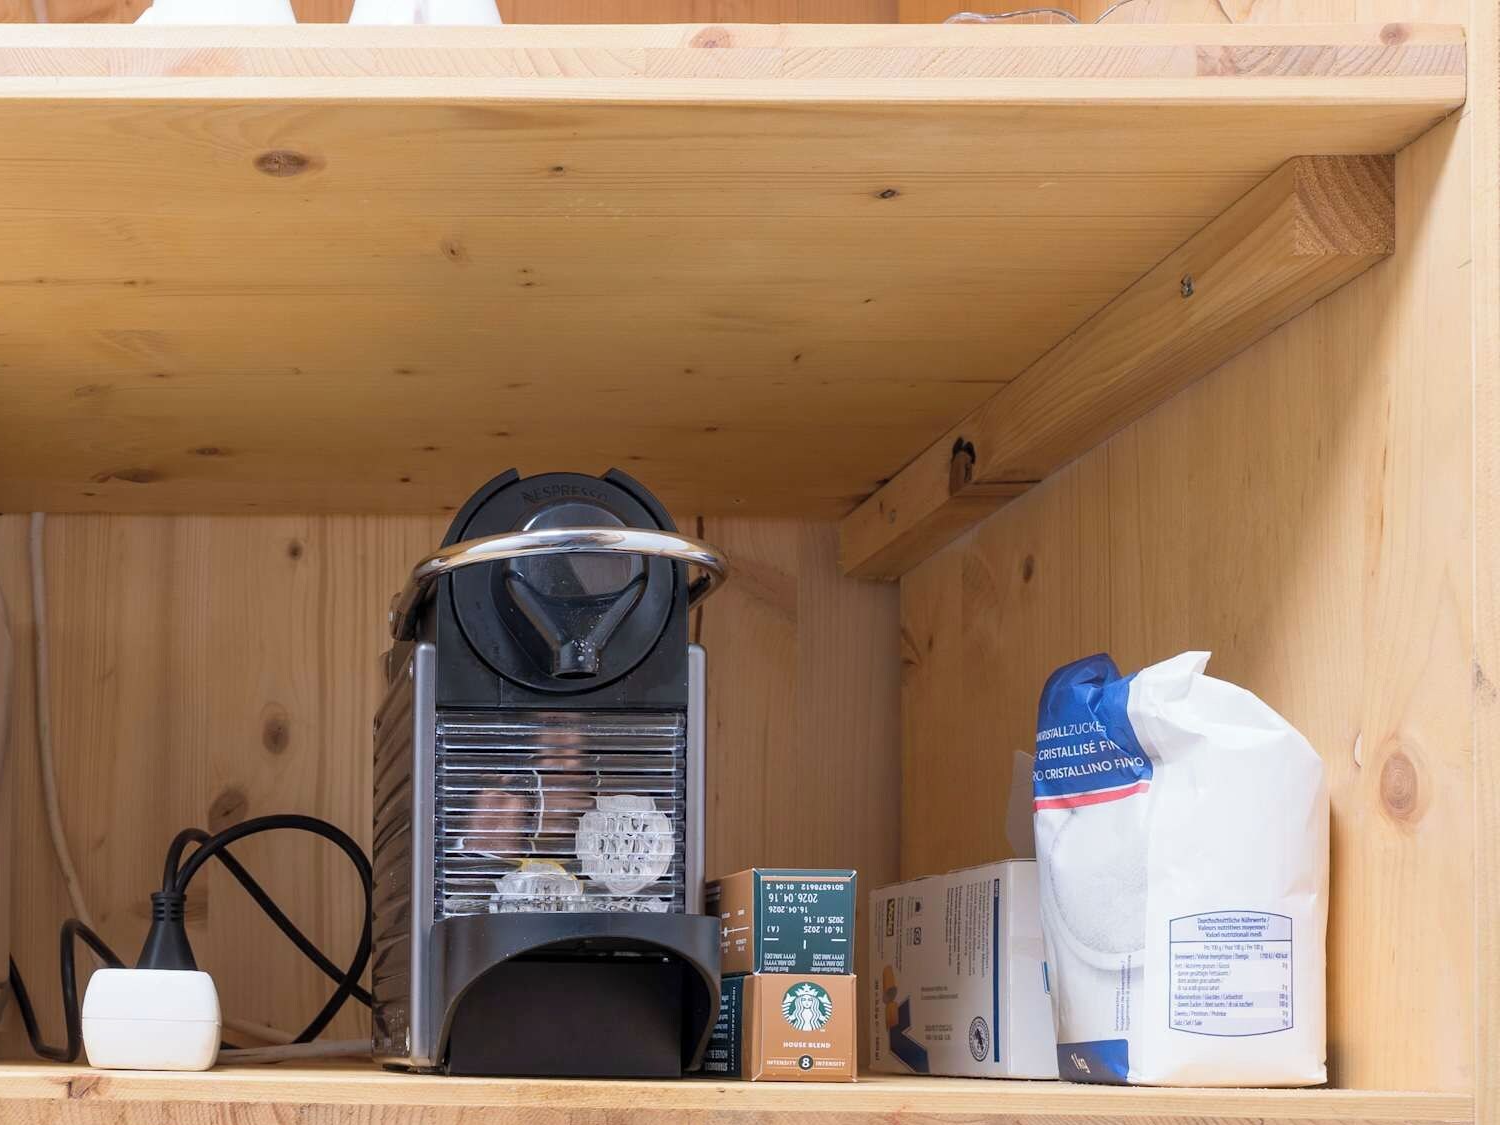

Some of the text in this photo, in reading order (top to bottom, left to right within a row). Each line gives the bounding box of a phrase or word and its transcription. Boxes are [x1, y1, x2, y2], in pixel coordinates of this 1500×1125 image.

[1038, 740, 1097, 761] CRISTALLISÉ
[1045, 760, 1112, 780] CRISTALLINO
[1115, 757, 1145, 769] FINO
[768, 893, 818, 903] 2026.04.16
[804, 916, 844, 924] 2025.01.16
[803, 925, 844, 934] 16.01.2025
[801, 1057, 811, 1068] 8
